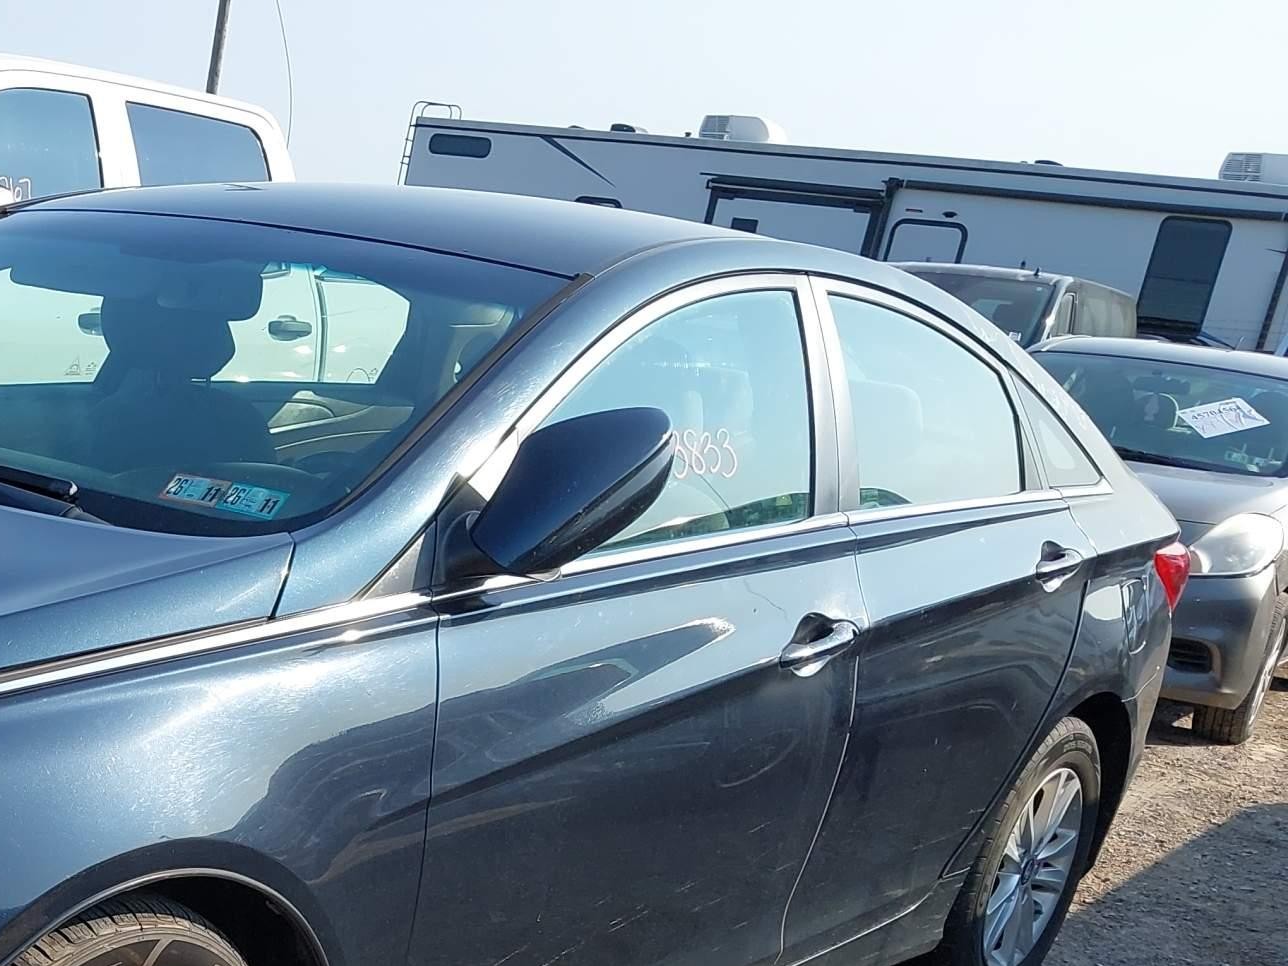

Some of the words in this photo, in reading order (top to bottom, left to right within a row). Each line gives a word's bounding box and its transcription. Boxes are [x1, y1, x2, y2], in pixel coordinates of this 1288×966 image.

[166, 477, 187, 496] 26
[200, 486, 221, 504] 11
[223, 486, 246, 506] 26
[260, 498, 281, 514] 11
